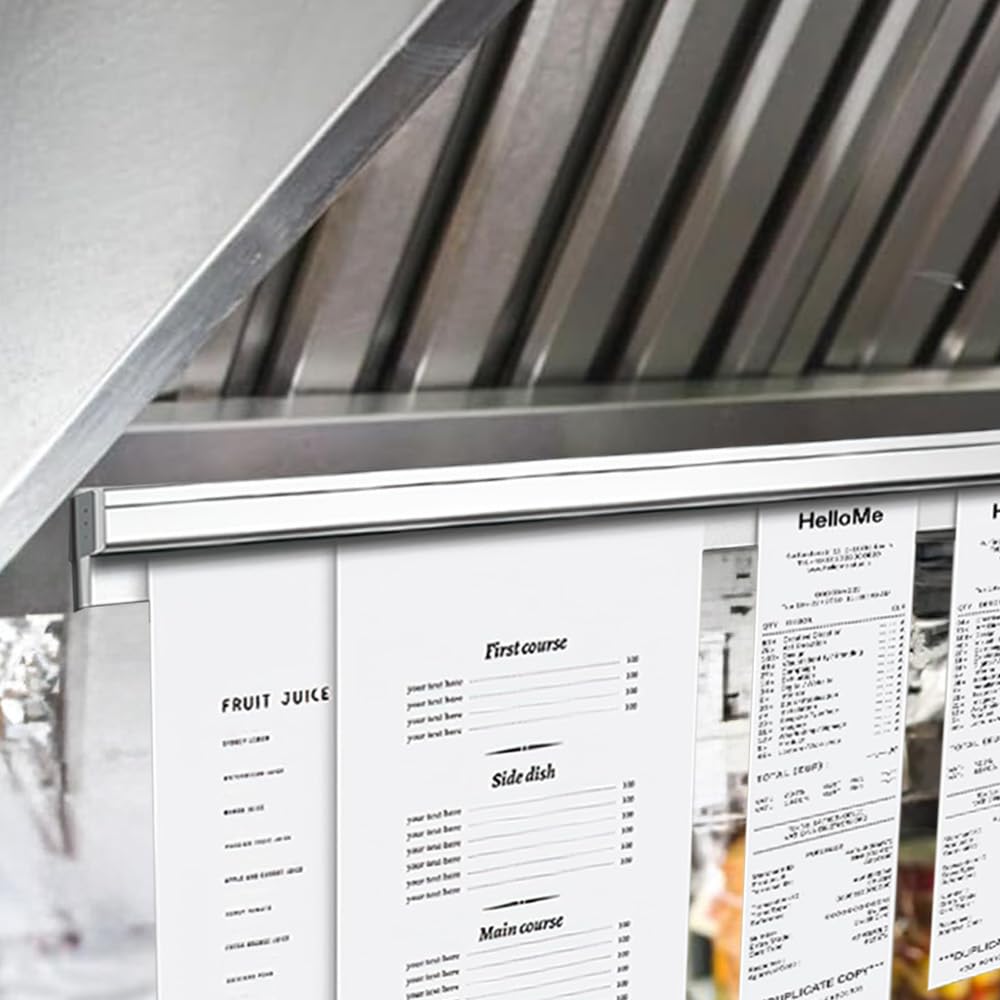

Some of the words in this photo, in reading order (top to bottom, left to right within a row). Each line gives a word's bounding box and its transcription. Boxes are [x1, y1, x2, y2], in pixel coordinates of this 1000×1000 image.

[798, 507, 884, 530] HelloMe
[485, 641, 522, 660] First
[521, 638, 568, 655] course
[222, 694, 270, 713] FRUIT
[281, 686, 330, 706] JUICE
[491, 768, 524, 788] Side
[525, 763, 555, 782] dish
[479, 922, 517, 942] Main
[519, 916, 564, 934] course
